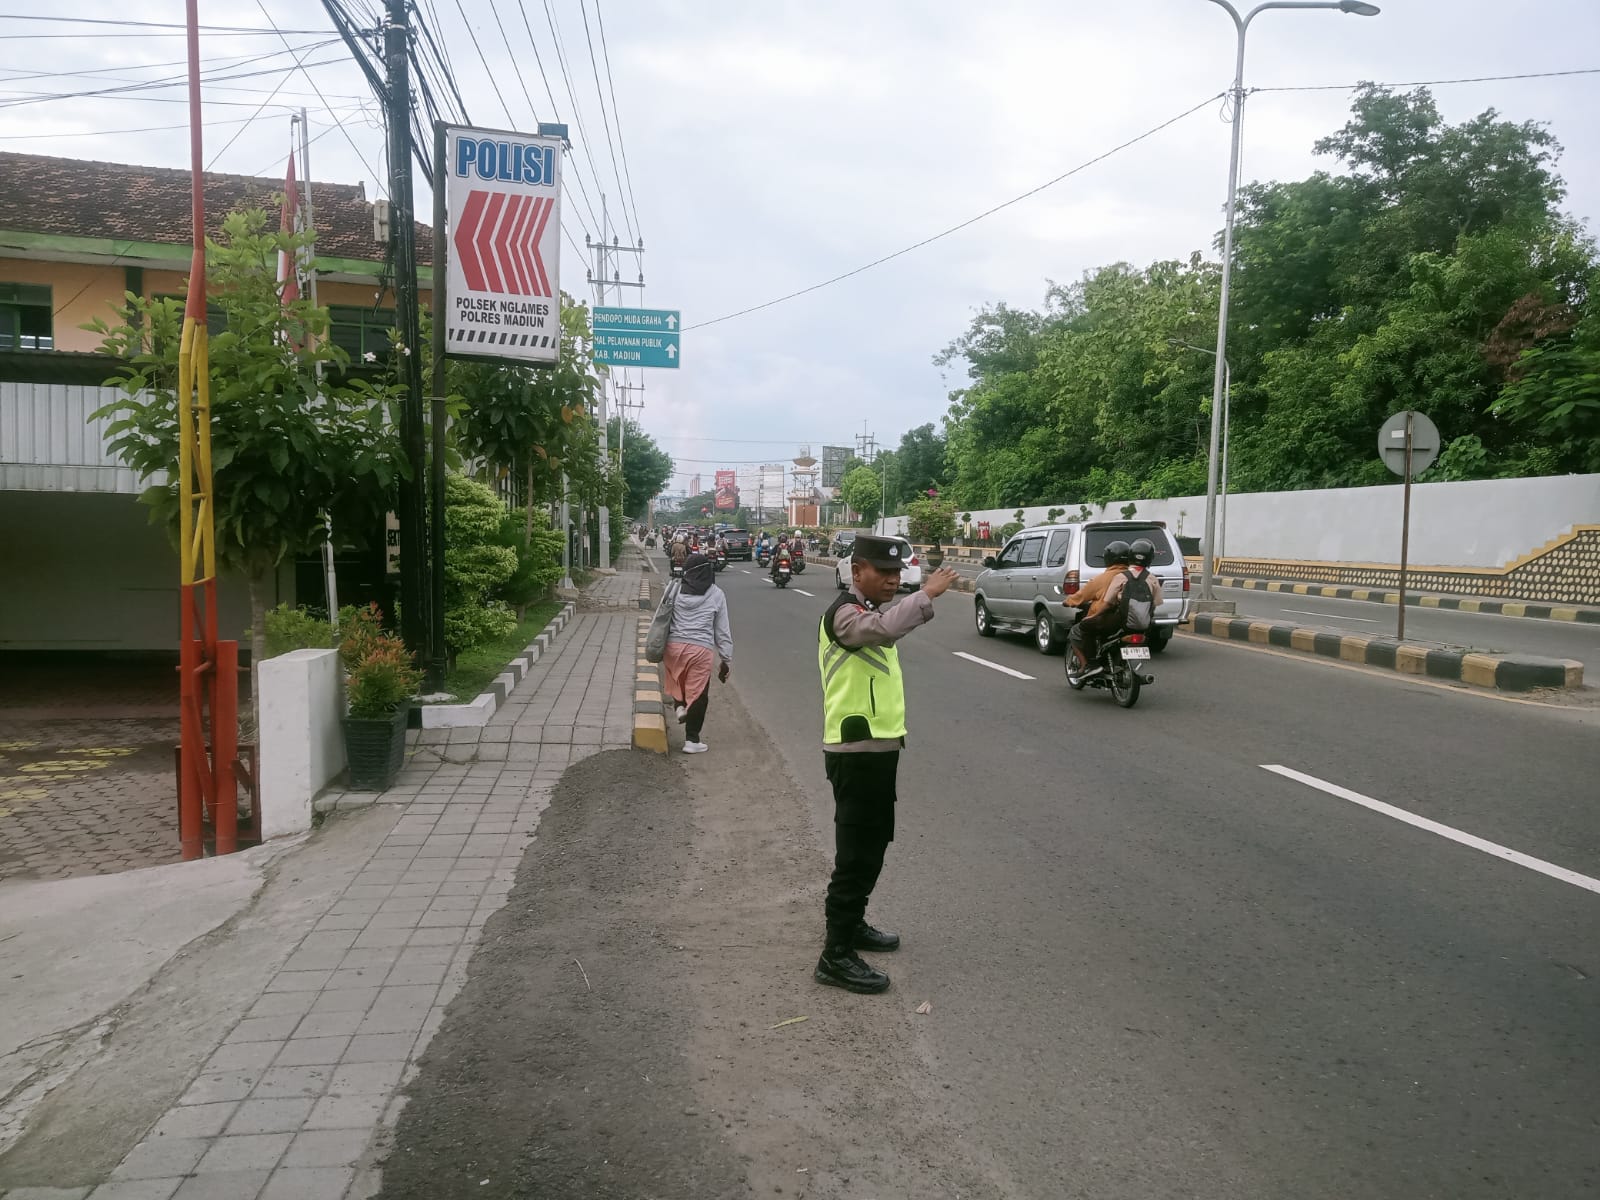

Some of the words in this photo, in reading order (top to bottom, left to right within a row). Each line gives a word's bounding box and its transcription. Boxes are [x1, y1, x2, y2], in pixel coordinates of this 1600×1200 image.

[456, 136, 556, 186] POLISI
[456, 297, 497, 312] POLSEK
[500, 301, 549, 316] NGLAMES
[461, 310, 501, 324] POLRES
[504, 314, 544, 328] MADIUN
[594, 313, 622, 323] PENDOPO
[624, 314, 641, 324] MUDA
[641, 315, 662, 326] GRAHA
[607, 336, 640, 346] PELAYANAN
[641, 337, 662, 348] PUBLIK
[613, 350, 641, 360] MADIUN
